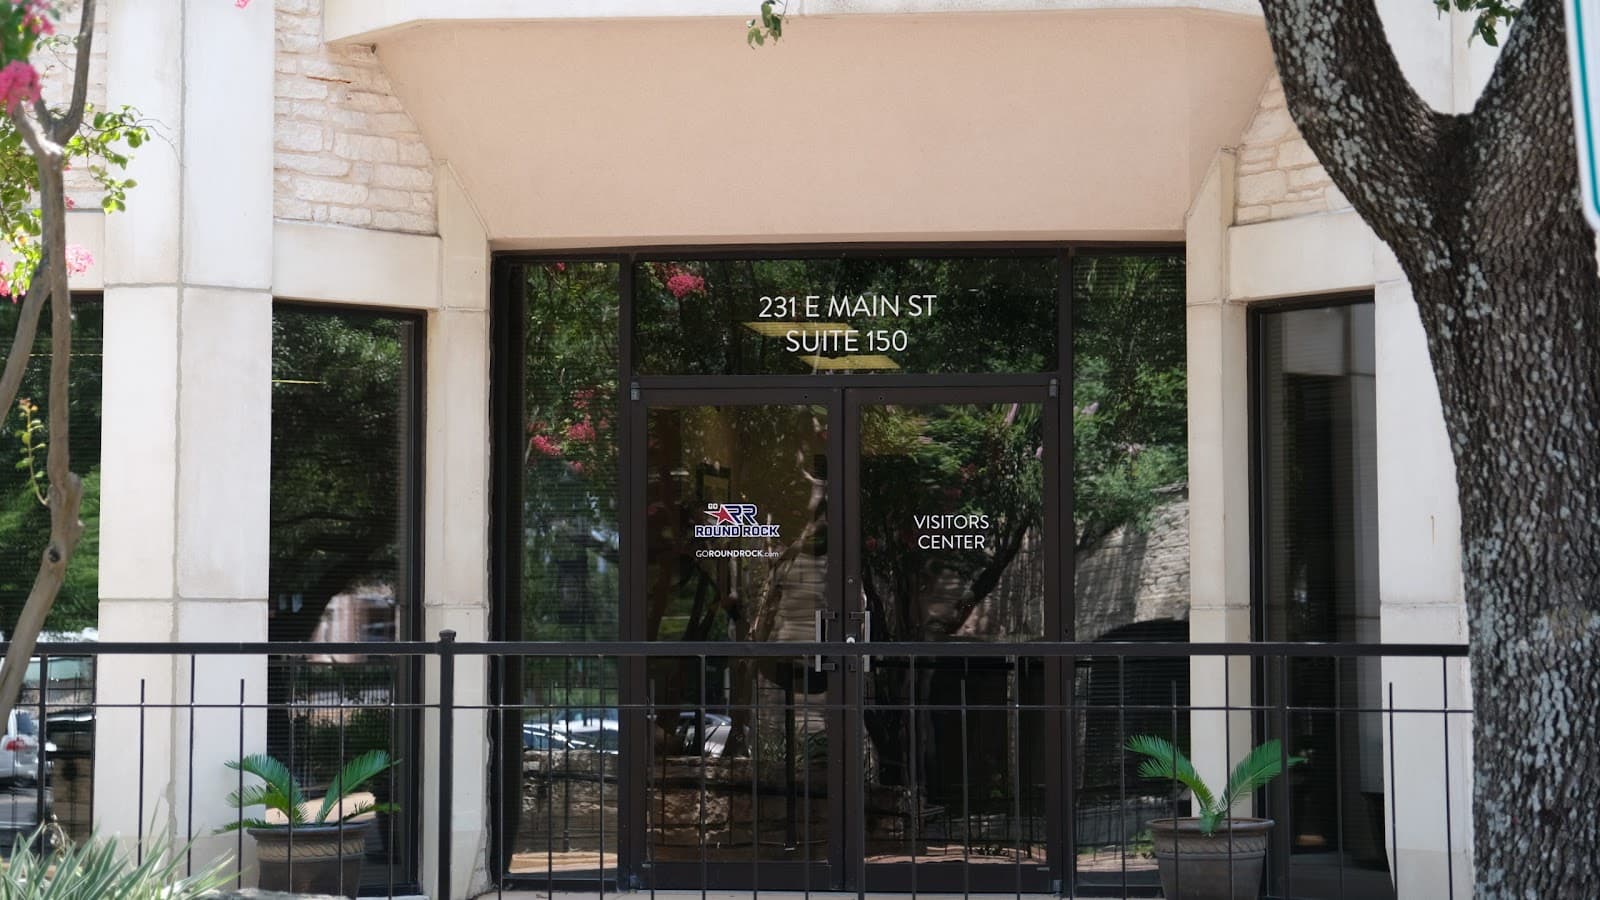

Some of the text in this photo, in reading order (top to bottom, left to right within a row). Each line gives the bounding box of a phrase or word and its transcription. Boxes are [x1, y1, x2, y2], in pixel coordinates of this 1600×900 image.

[758, 294, 937, 318] 231 E MAIN ST
[786, 330, 908, 352] SUITE 150
[913, 514, 990, 529] VISITORS
[695, 525, 780, 538] ROUND ROCK
[918, 534, 986, 550] CENTER
[695, 550, 779, 558] GOROUNDROCK.com
